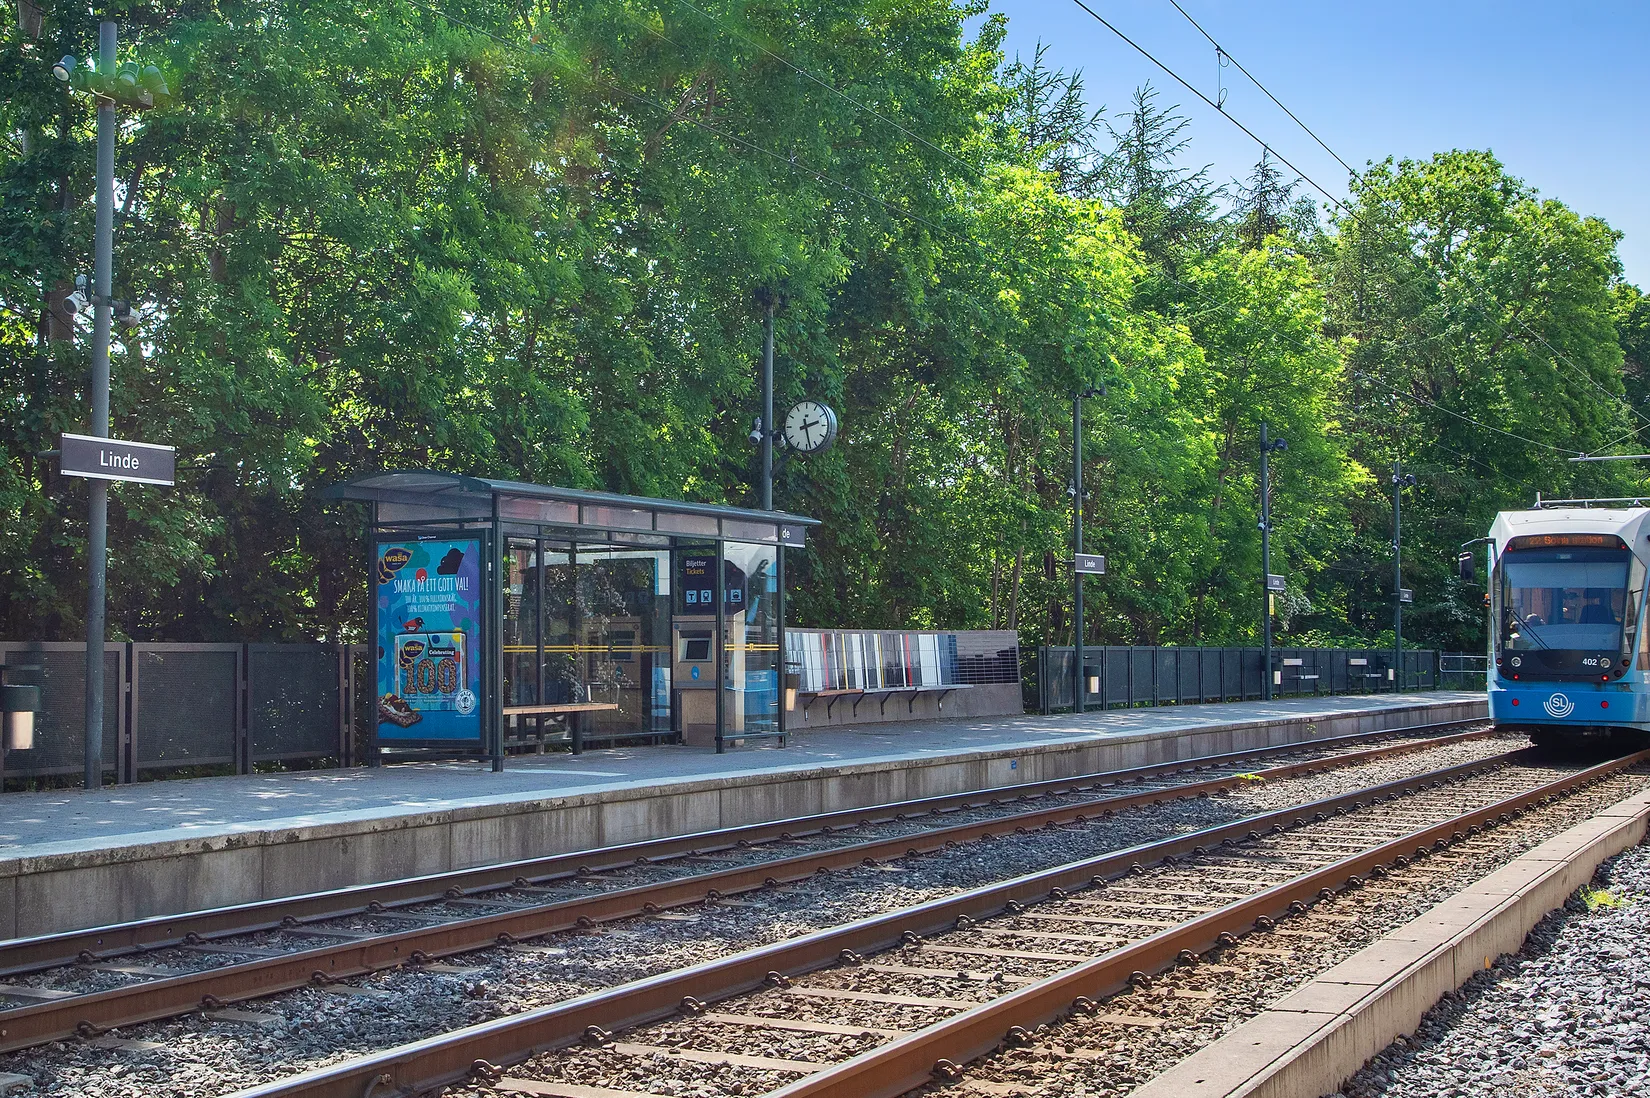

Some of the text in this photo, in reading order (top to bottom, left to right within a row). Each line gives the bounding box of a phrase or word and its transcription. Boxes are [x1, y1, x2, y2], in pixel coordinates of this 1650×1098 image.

[100, 450, 140, 470] Linde
[685, 560, 707, 568] Biljetter
[1084, 560, 1096, 568] Linde
[393, 575, 469, 594] SMAKA PÅ ETT GOTT VAL!
[401, 658, 457, 694] 100
[1552, 697, 1566, 707] SL
